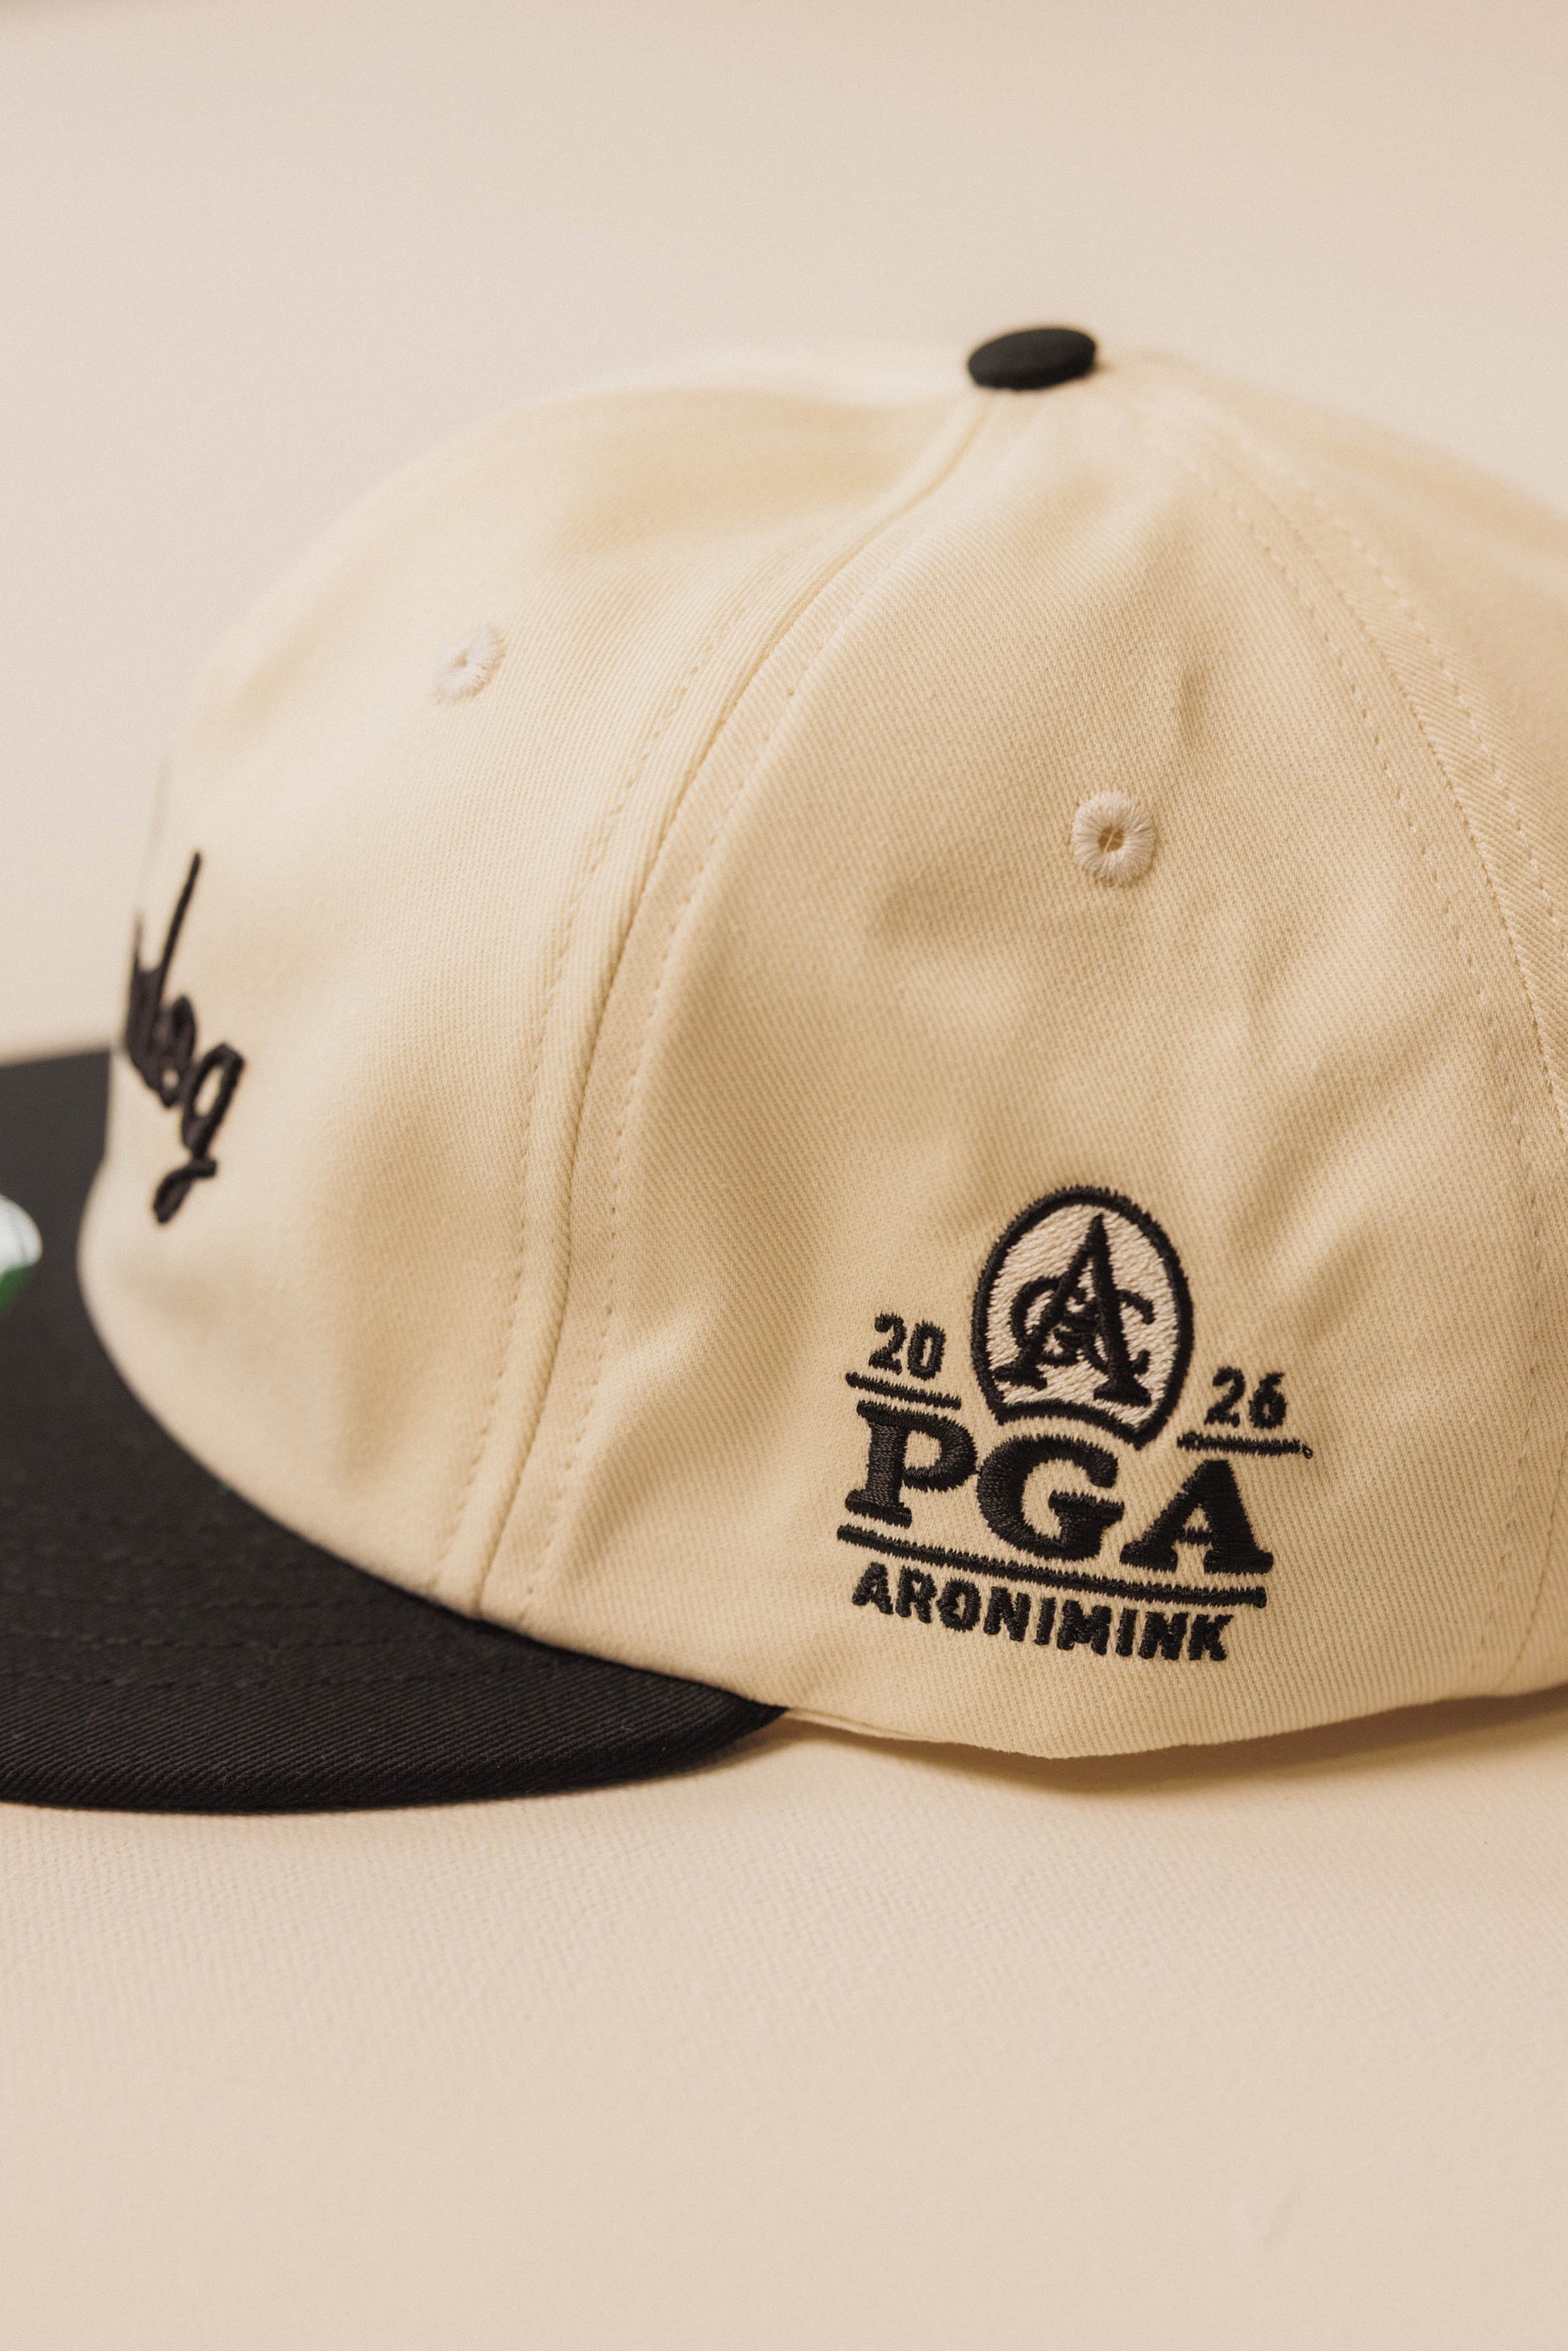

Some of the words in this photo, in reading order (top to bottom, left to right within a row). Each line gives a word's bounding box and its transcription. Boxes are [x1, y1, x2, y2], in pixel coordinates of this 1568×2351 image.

[867, 1312, 947, 1383] 20
[1203, 1365, 1288, 1431] 26
[844, 1399, 1275, 1577] PGA
[851, 1561, 1235, 1663] ARONIMINK
